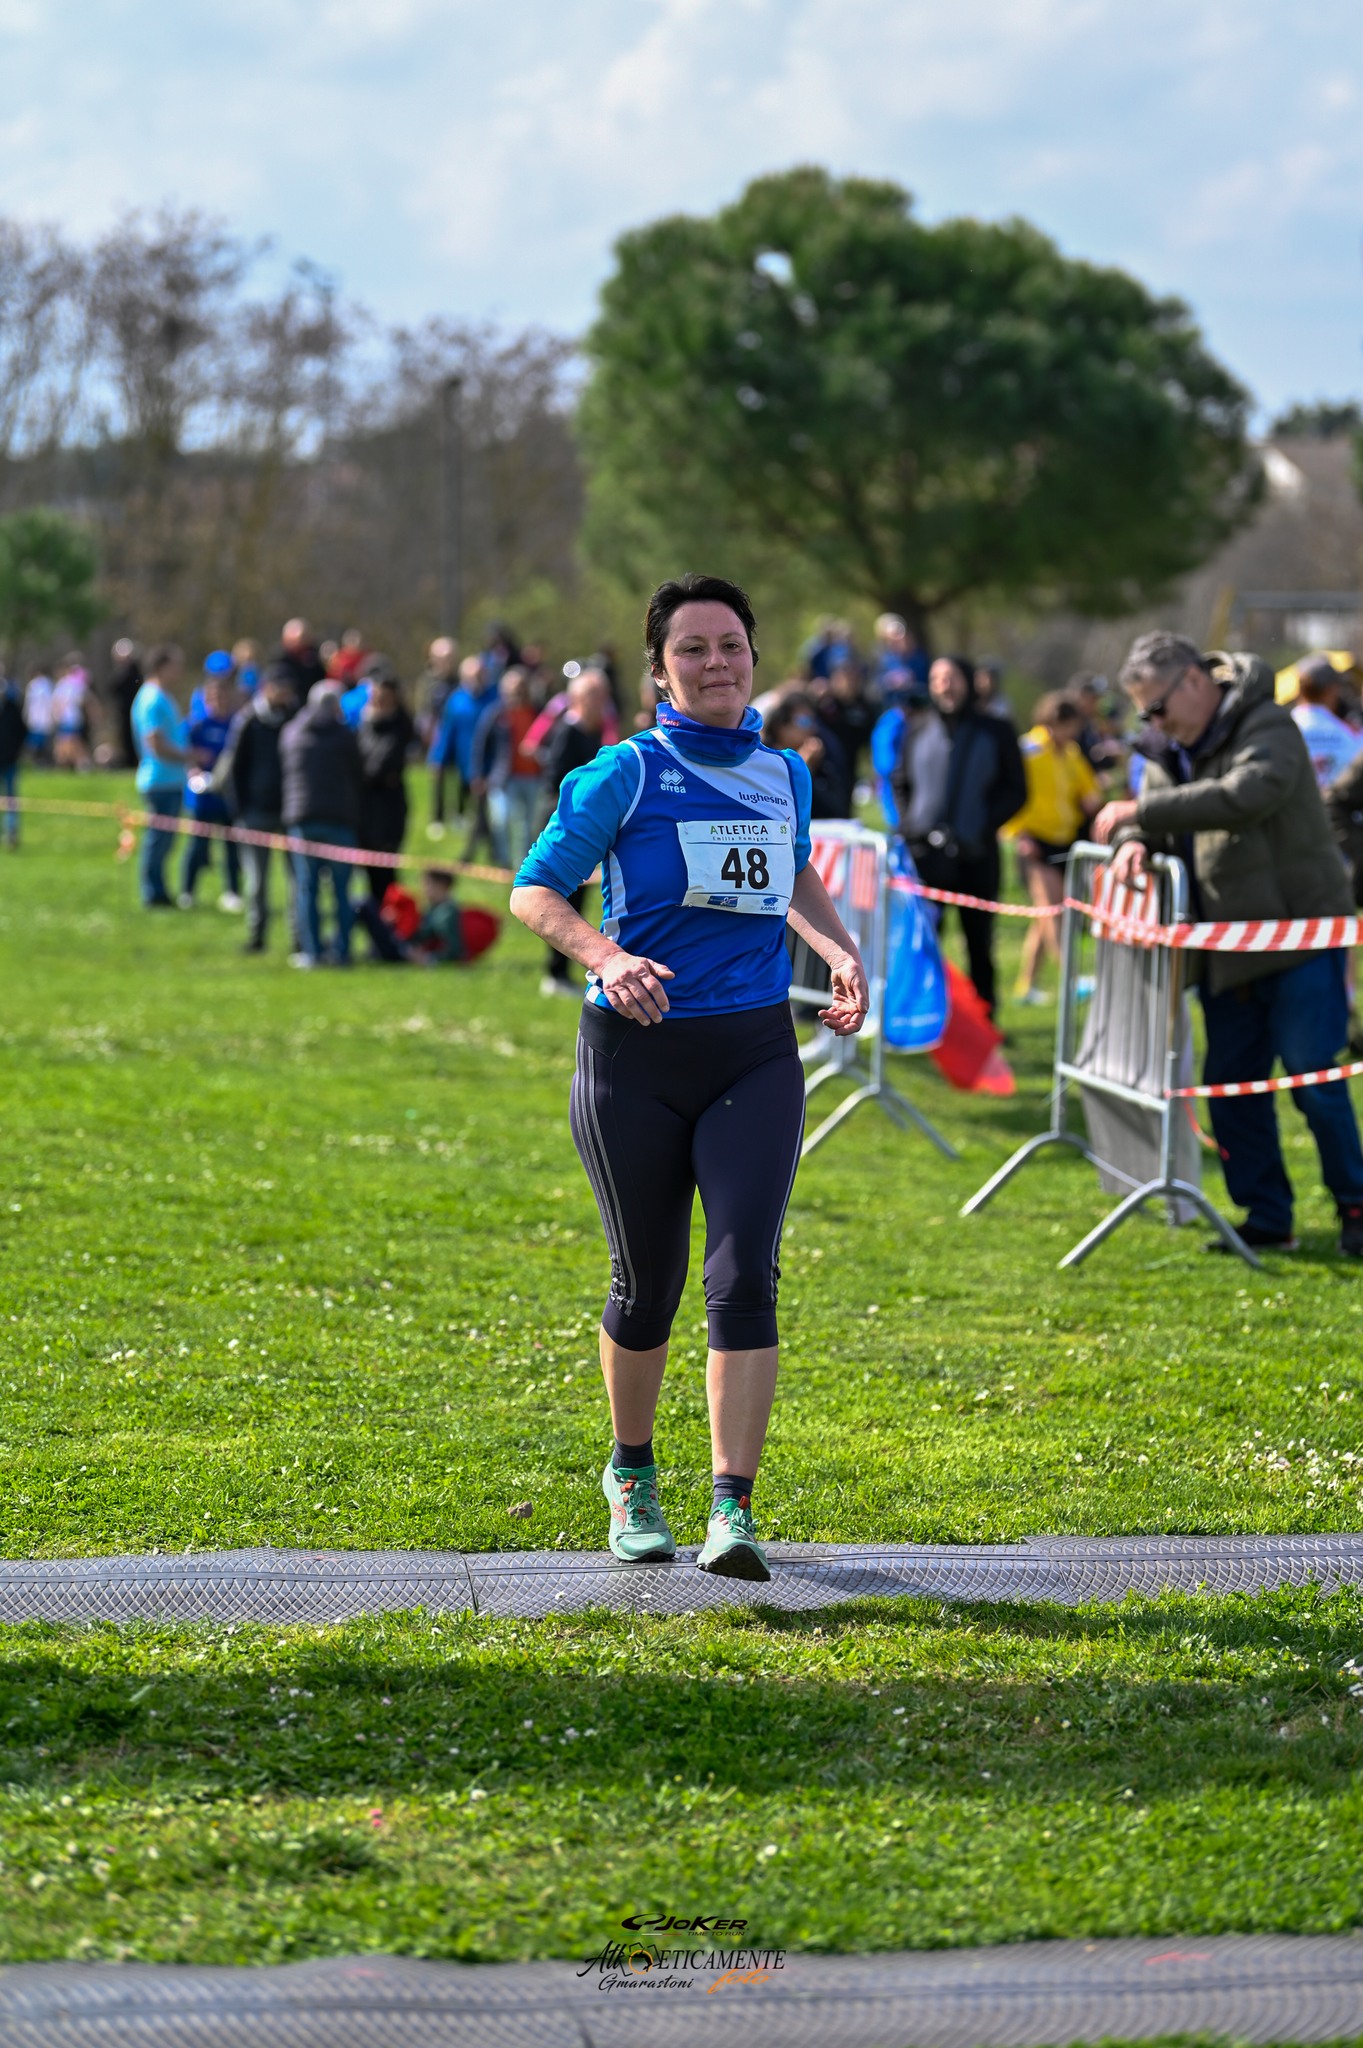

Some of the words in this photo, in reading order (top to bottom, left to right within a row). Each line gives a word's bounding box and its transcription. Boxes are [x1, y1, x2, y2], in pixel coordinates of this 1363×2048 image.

[660, 783, 687, 794] errea
[738, 791, 788, 807] lughesina
[710, 824, 769, 835] ATLETICA
[721, 848, 770, 890] 48
